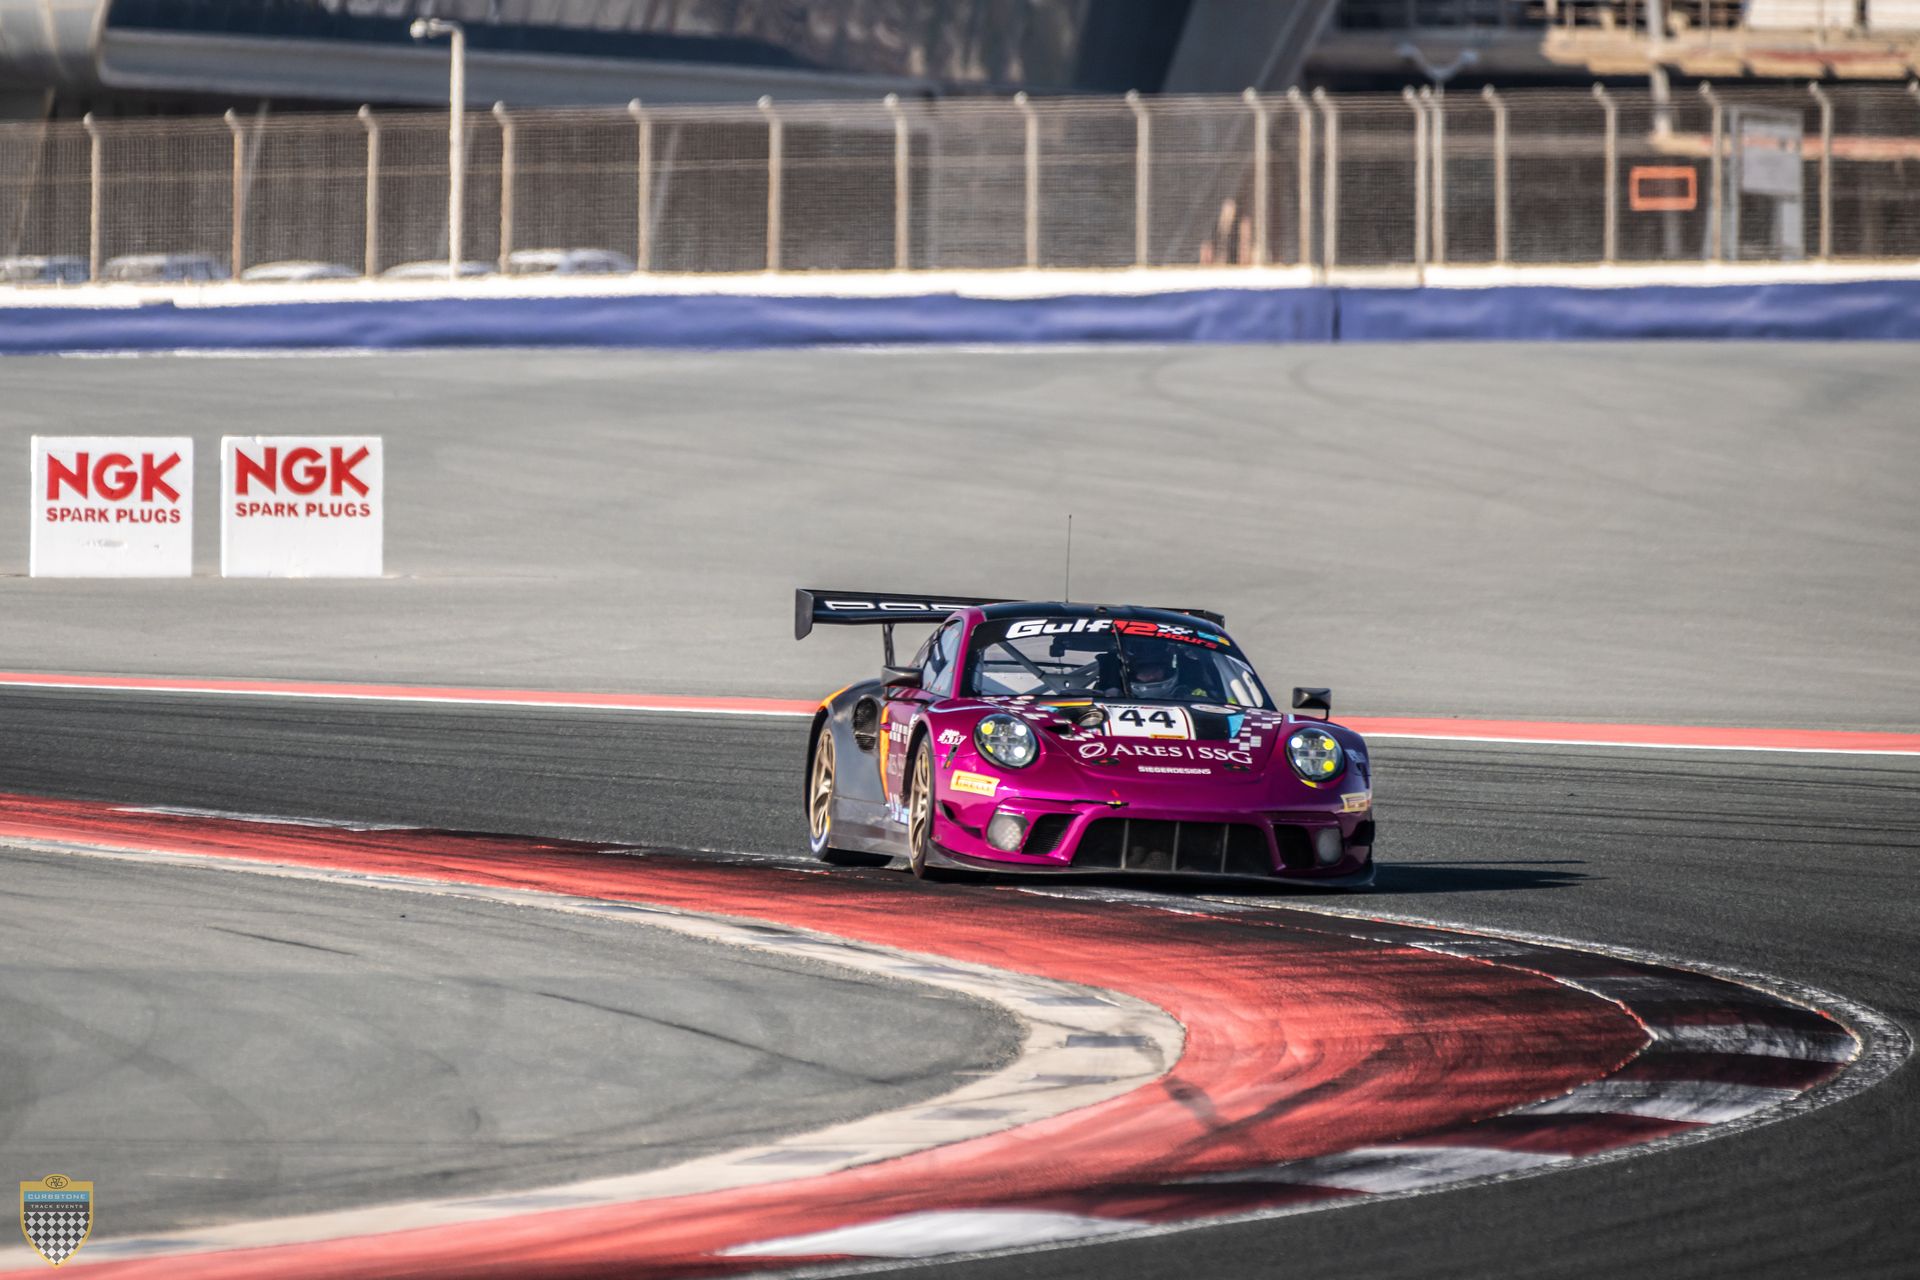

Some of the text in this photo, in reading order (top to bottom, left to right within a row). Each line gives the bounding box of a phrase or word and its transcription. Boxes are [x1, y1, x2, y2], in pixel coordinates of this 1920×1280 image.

[47, 452, 181, 503] NGK
[235, 446, 370, 498] NGK
[46, 507, 181, 524] SPARK PLUGS
[235, 502, 371, 518] SPARK PLUGS
[1005, 619, 1113, 639] Gulf
[1118, 709, 1176, 728] 44
[1112, 744, 1253, 764] ARES SSG
